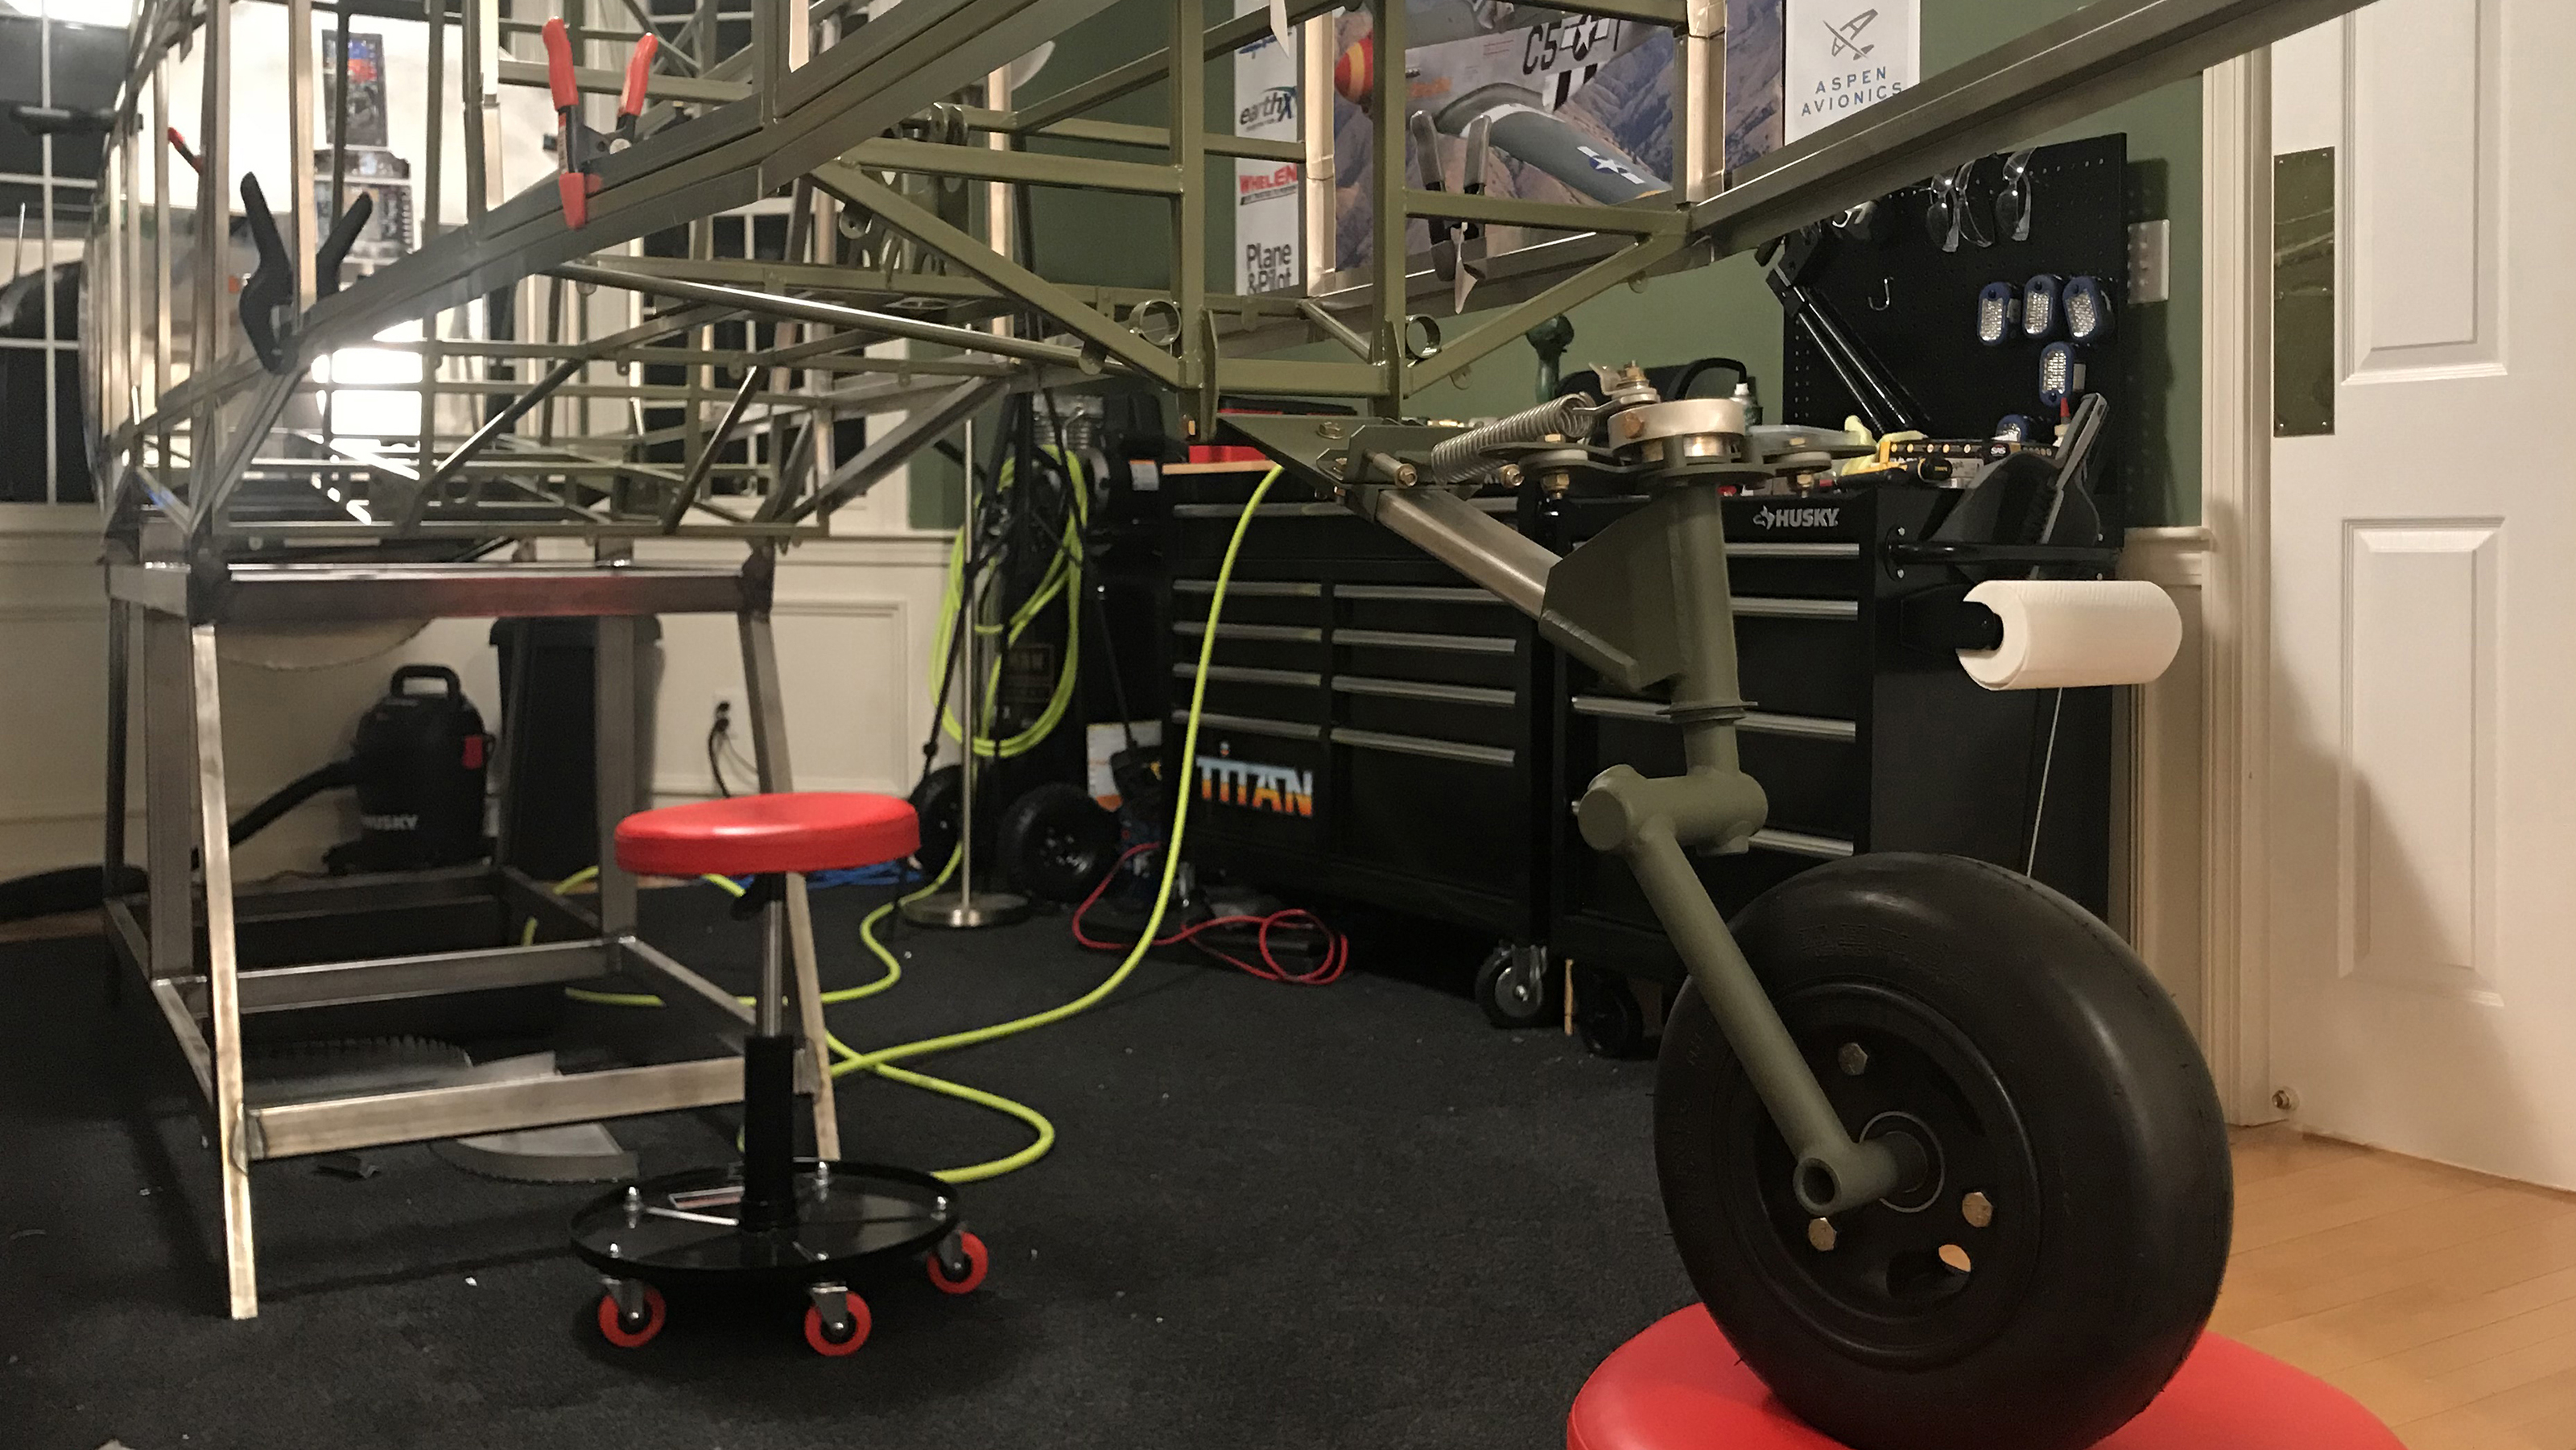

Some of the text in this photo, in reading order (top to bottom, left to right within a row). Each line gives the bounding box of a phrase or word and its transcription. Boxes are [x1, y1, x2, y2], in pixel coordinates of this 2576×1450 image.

[1814, 66, 1886, 94] ASPEN
[1801, 81, 1902, 117] AVIONICS
[1240, 163, 1297, 194] WHELEN
[1246, 242, 1291, 270] Plane
[1776, 507, 1839, 527] HUSKY
